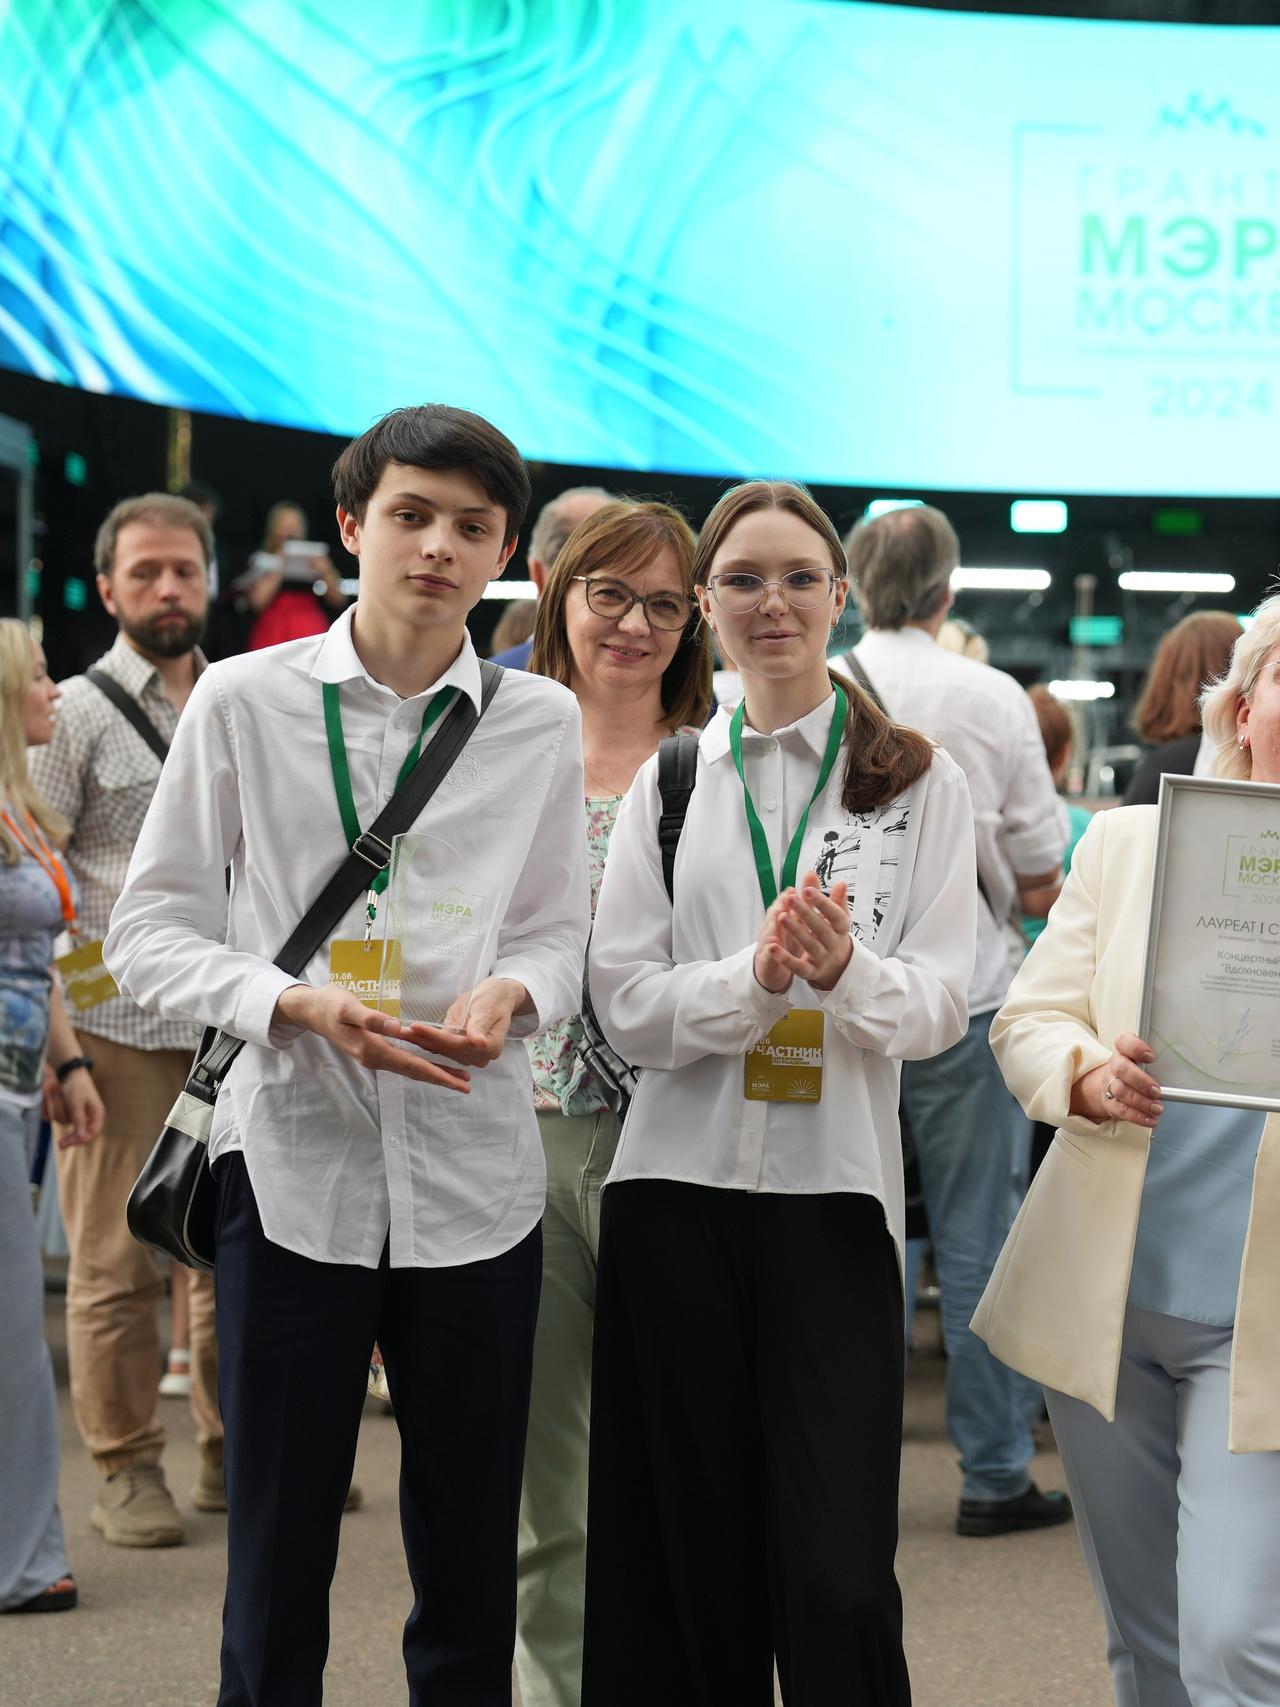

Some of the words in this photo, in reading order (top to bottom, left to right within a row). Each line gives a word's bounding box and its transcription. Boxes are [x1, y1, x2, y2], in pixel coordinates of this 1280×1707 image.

[1149, 375, 1272, 417] 2024
[1252, 894, 1280, 905] 2024
[432, 901, 472, 917] МЭРА
[431, 913, 472, 926] МОСКВЫ
[1196, 916, 1256, 933] ЛАУРЕАТ
[1217, 950, 1280, 965] Концертный
[330, 972, 352, 980] 01.06
[330, 980, 400, 992] ЧАСТНИК
[757, 1037, 770, 1045] .06
